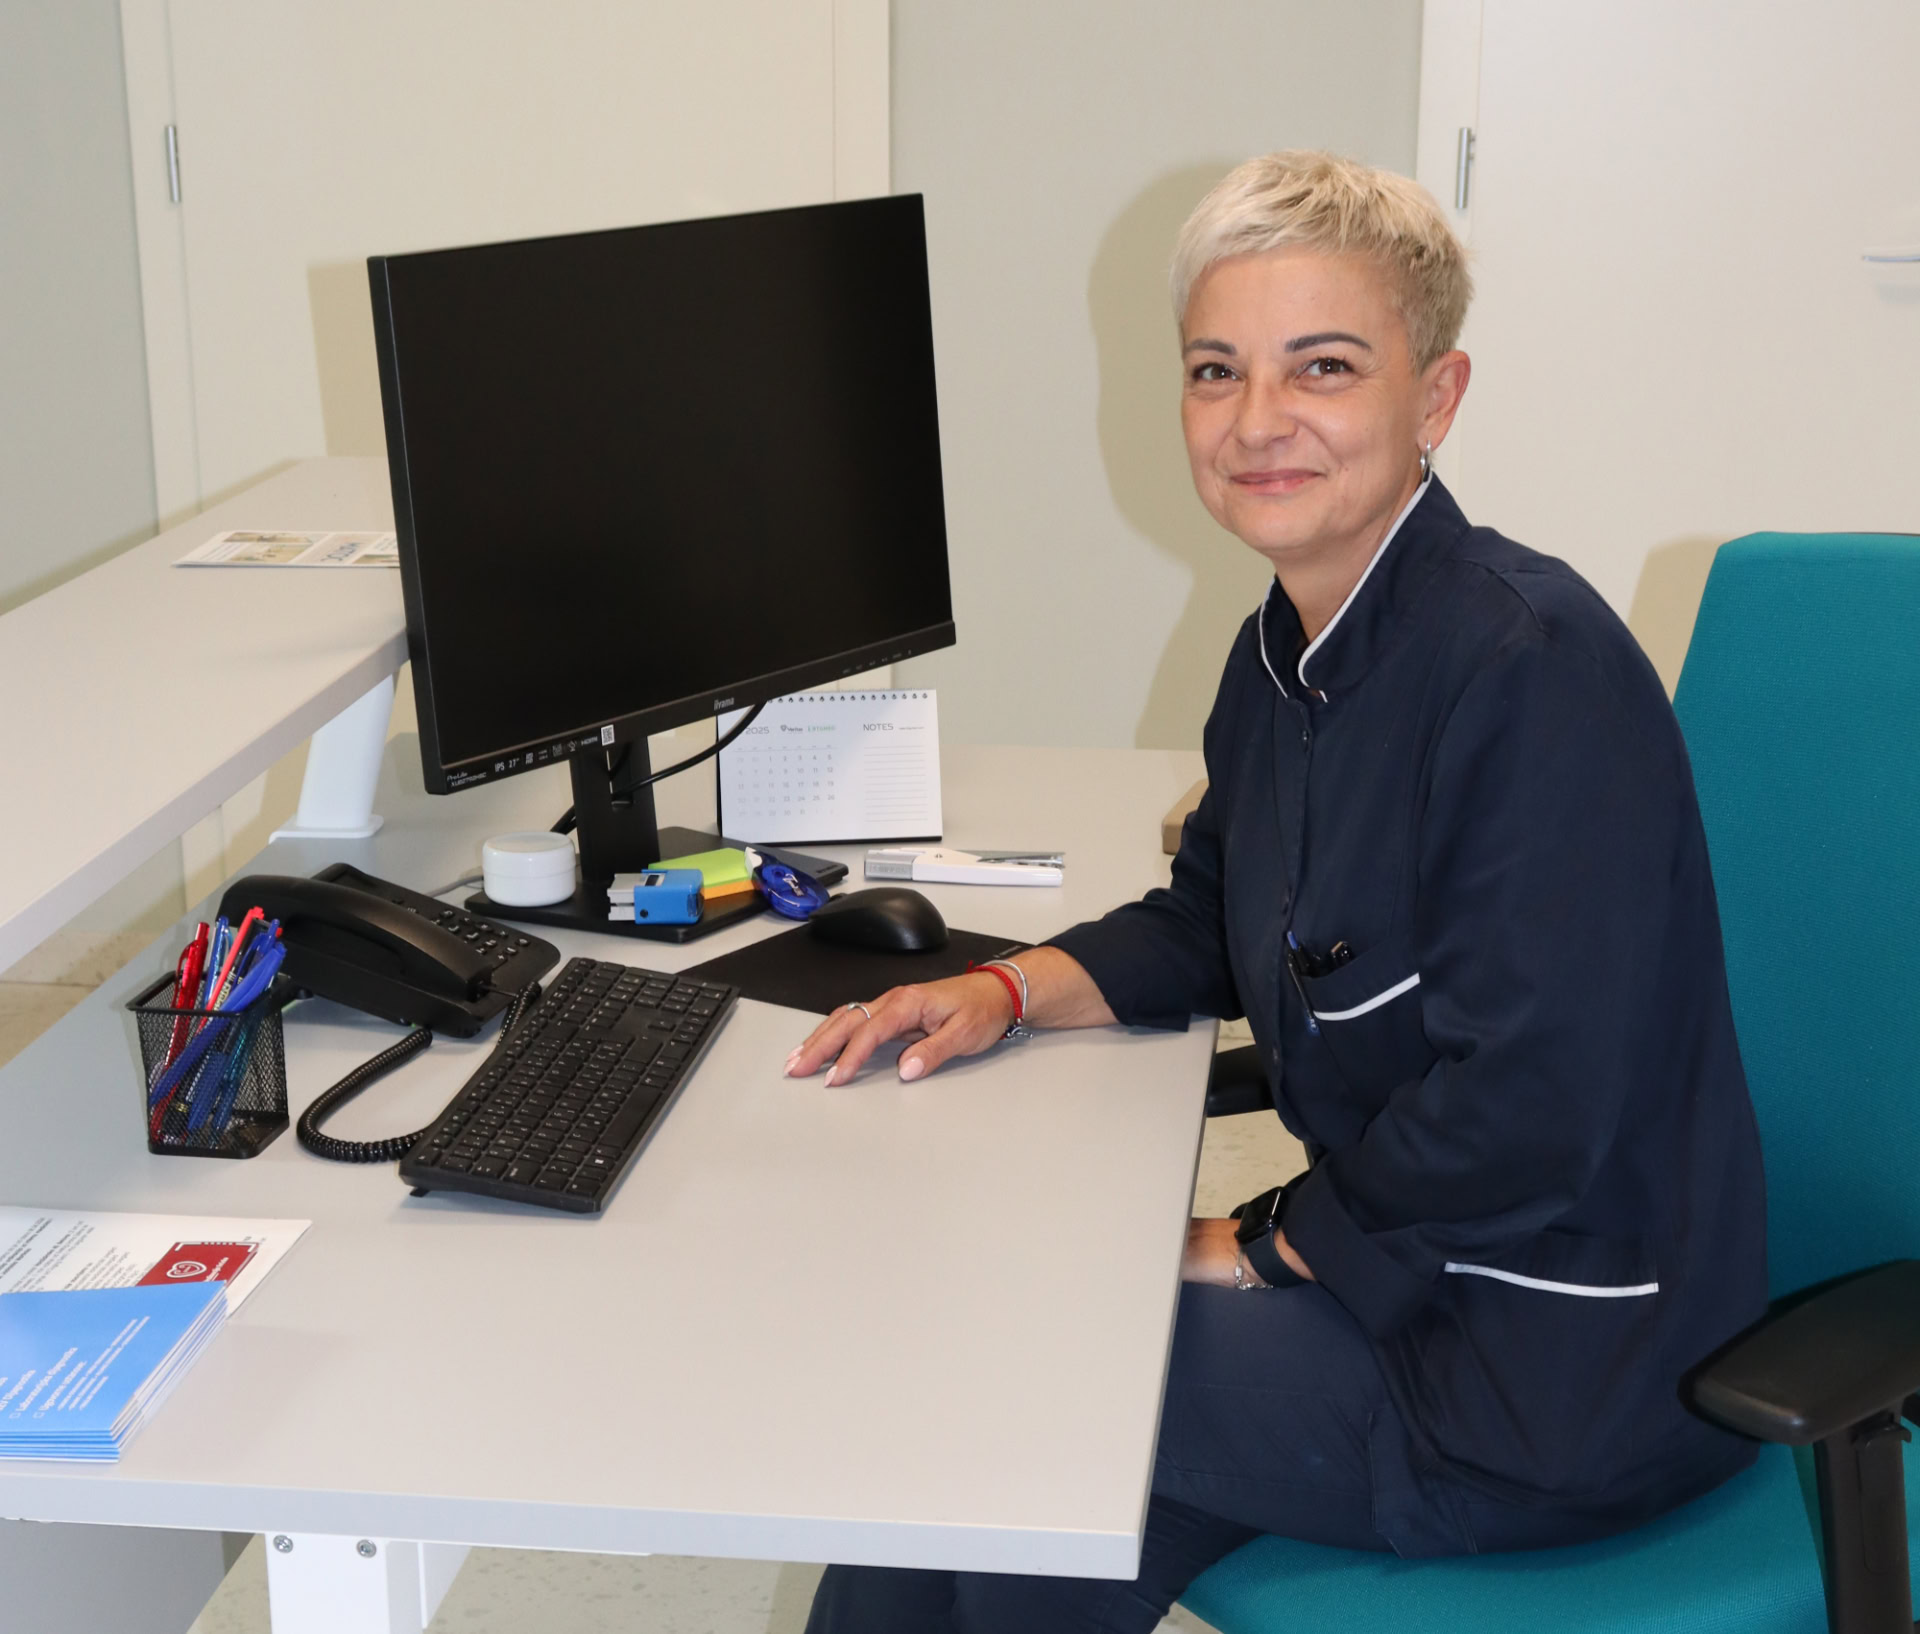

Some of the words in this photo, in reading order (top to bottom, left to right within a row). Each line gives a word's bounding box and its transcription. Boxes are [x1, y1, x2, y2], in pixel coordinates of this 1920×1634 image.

[713, 697, 735, 711] iiyama
[745, 726, 770, 735] 2025
[863, 723, 894, 731] NOTES
[494, 761, 505, 773] IPS
